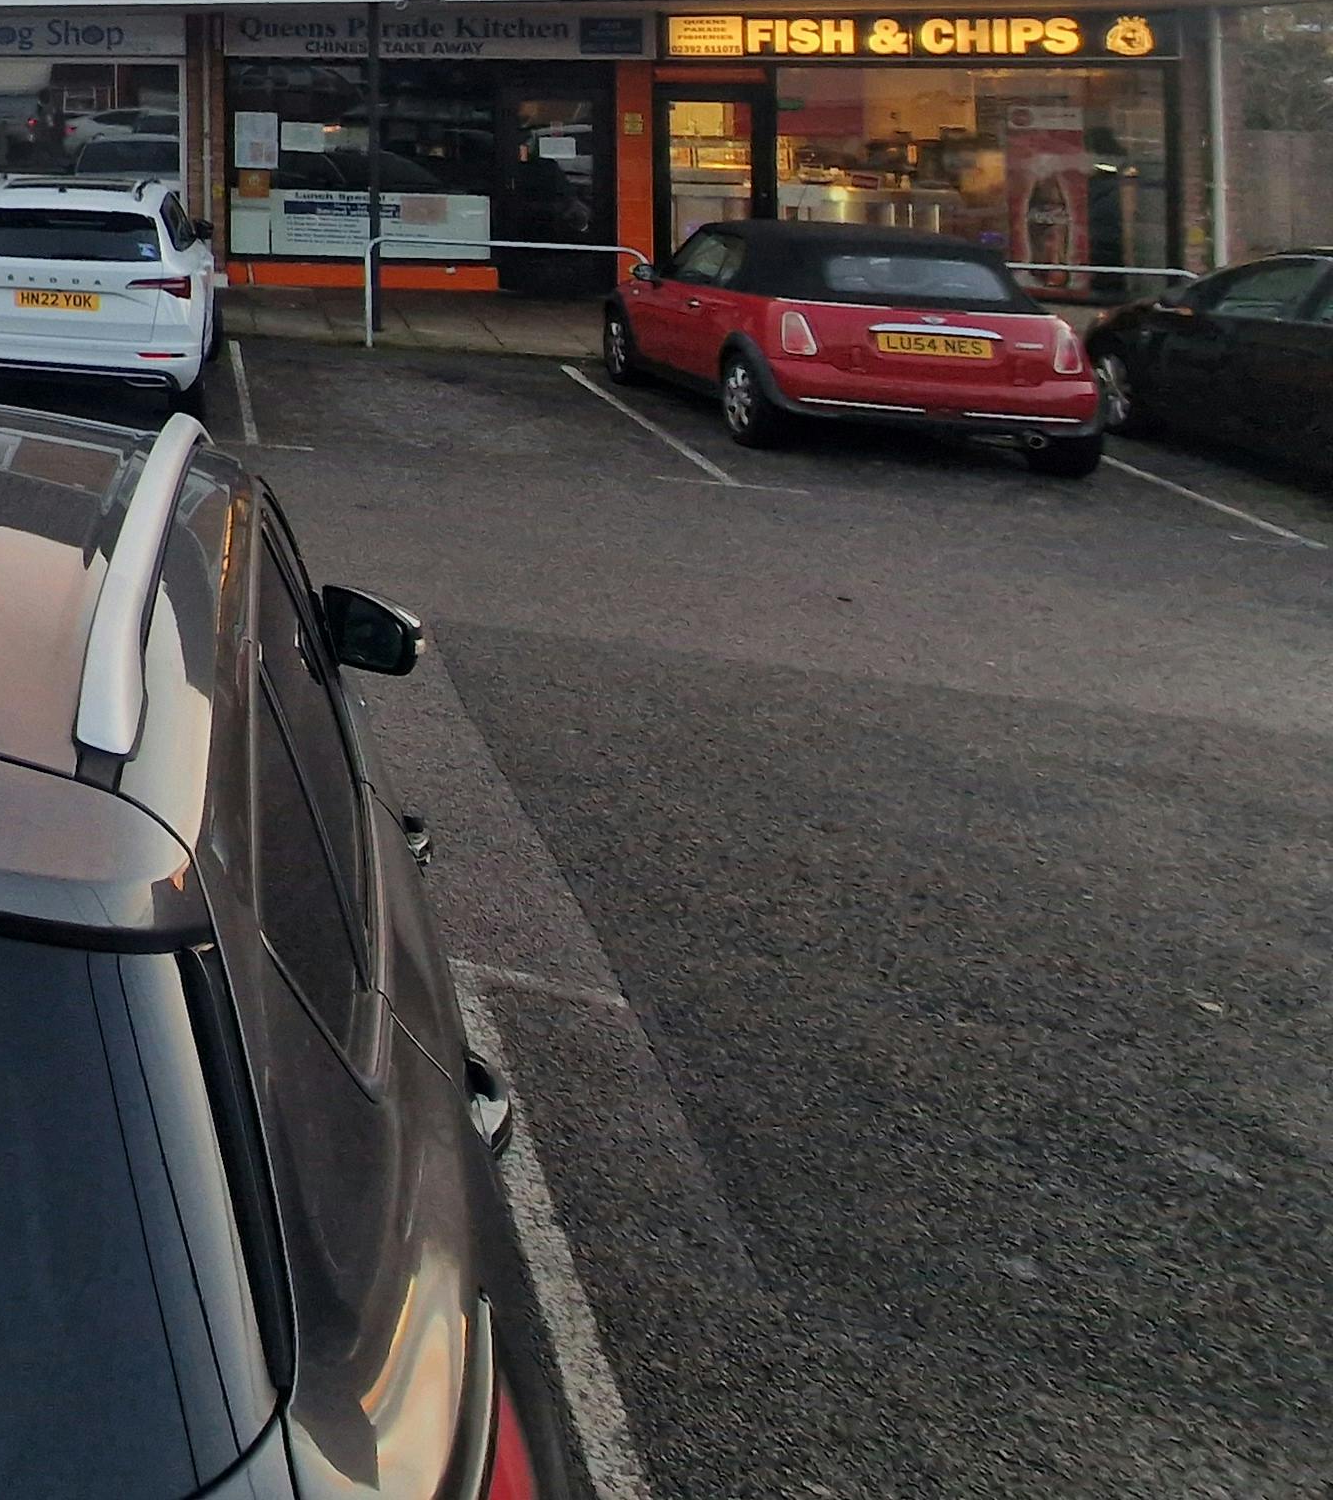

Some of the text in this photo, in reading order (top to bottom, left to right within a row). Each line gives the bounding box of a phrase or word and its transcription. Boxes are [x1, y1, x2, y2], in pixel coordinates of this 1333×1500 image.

[47, 19, 125, 50] Shop
[240, 17, 337, 41] Queens
[347, 17, 445, 38] Prade
[455, 16, 569, 38] Kitchen
[746, 17, 1080, 54] FISH & CHIPS
[306, 41, 485, 55] CHINES TAKE AWAY
[295, 191, 333, 200] Lunch
[20, 291, 93, 308] HN22 YOK
[886, 335, 983, 355] LU54 NES
